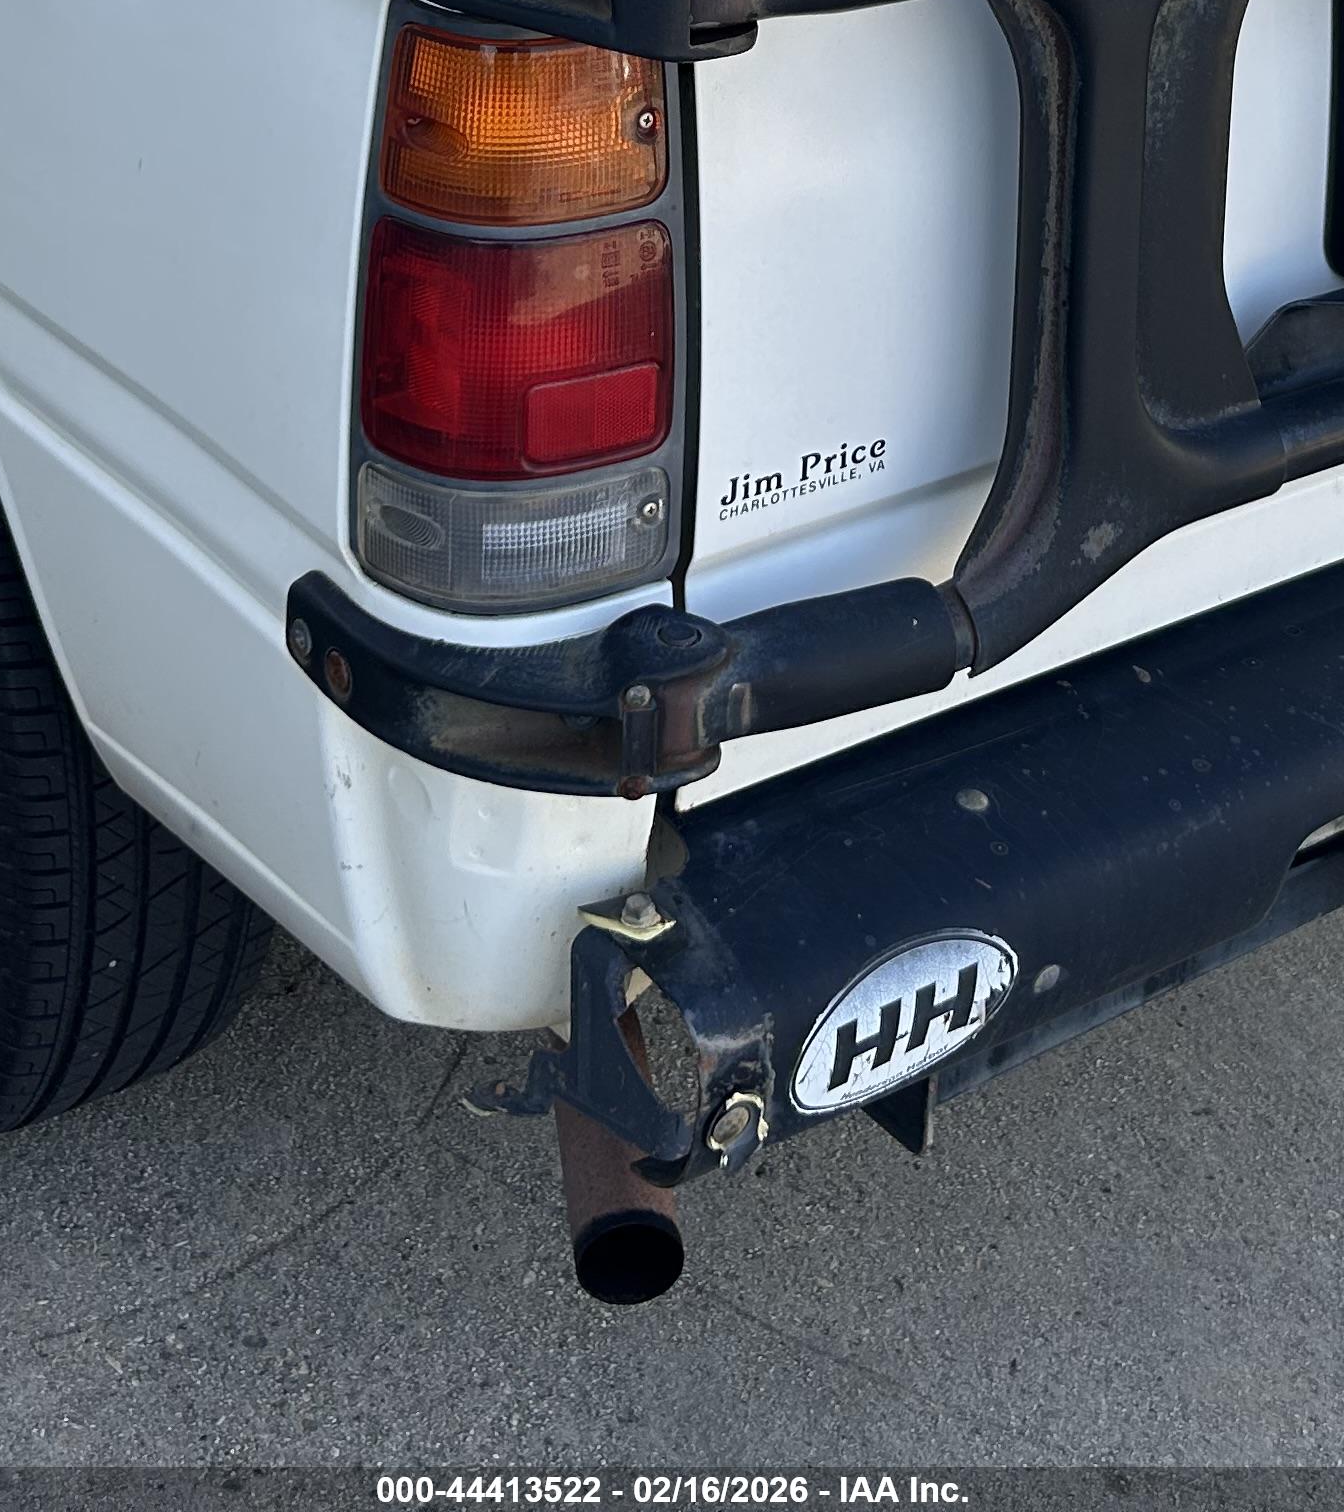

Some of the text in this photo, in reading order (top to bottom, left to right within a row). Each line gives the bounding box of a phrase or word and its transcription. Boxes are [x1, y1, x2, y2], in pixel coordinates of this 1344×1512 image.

[719, 459, 885, 521] CHARLOTTESVILLE, VA
[720, 438, 886, 506] Jim Price
[827, 962, 978, 1092] HH
